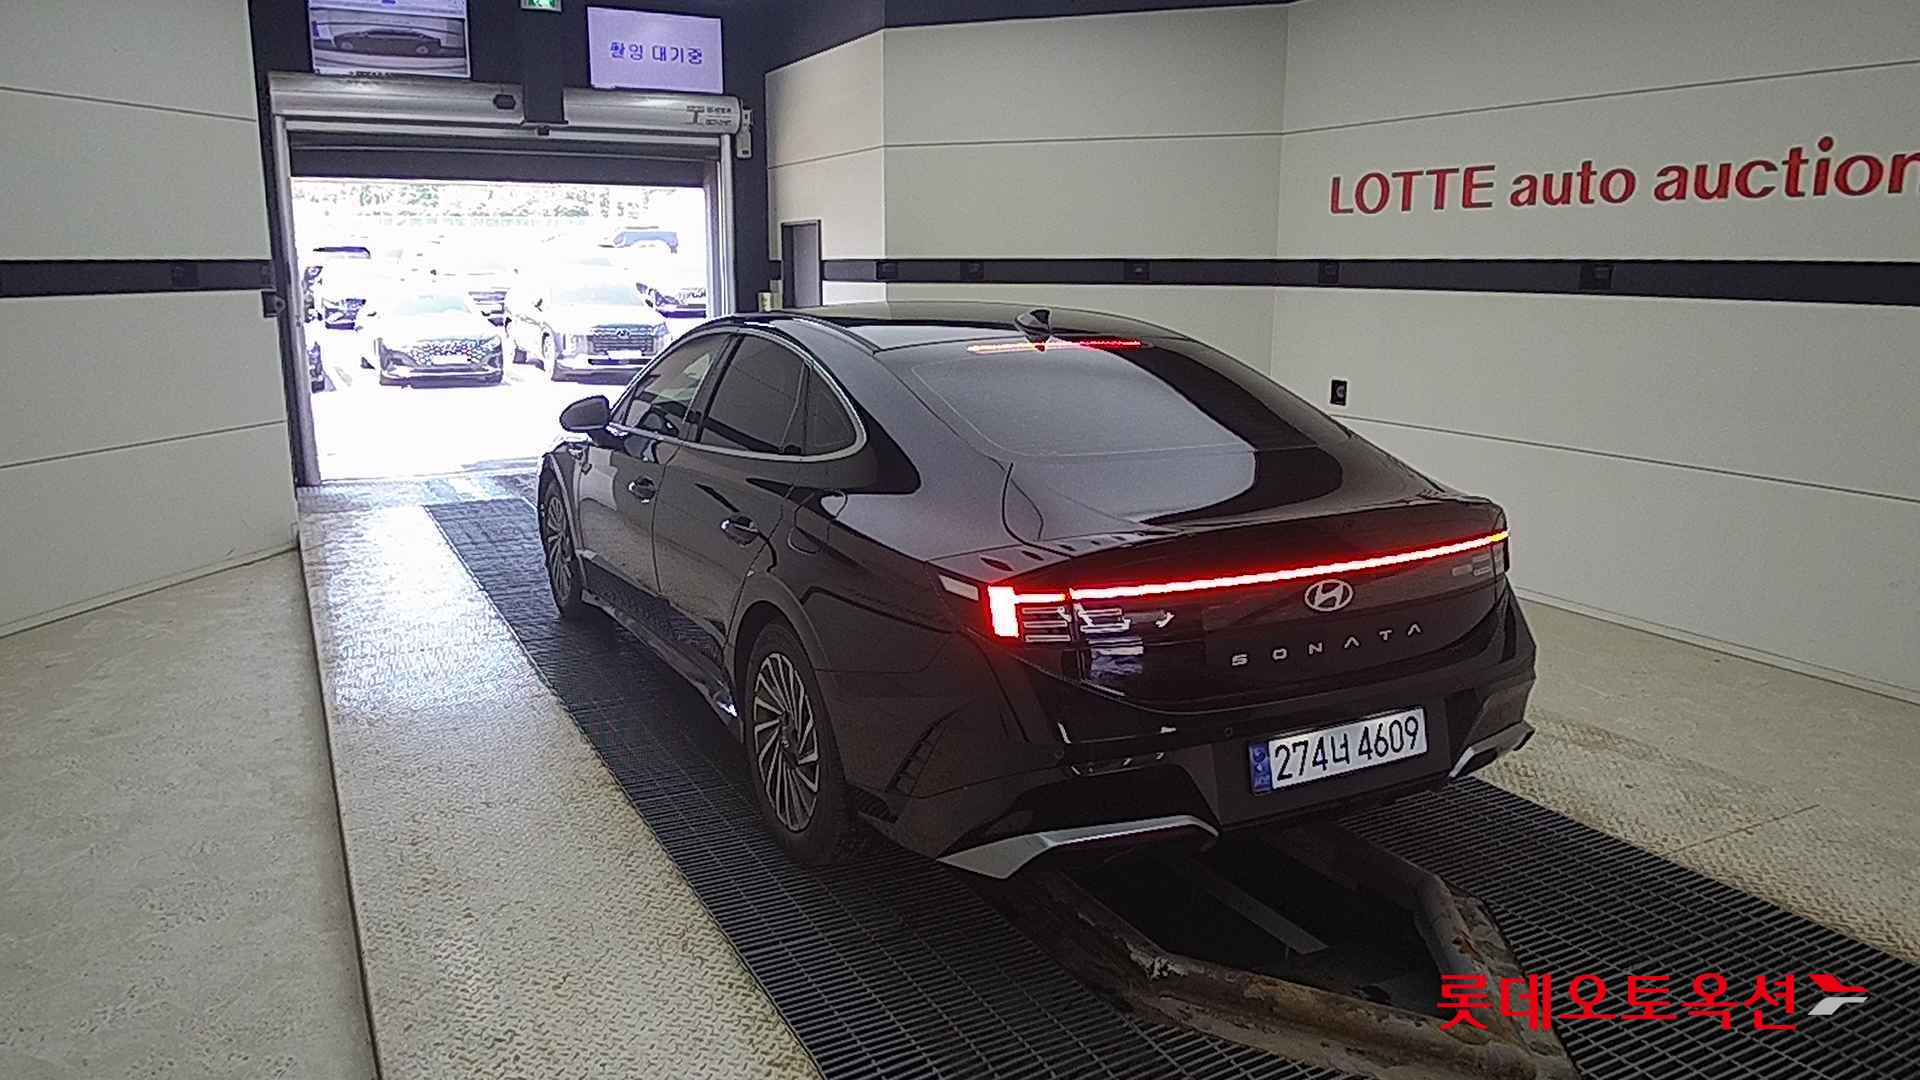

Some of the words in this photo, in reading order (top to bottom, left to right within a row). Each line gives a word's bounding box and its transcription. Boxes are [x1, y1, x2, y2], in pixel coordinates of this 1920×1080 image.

[651, 44, 703, 65] 대기중
[1330, 164, 1496, 214] LOTTE
[1510, 160, 1636, 207] auto
[1231, 623, 1422, 667] SONATA
[1274, 733, 1350, 782] 274너
[1357, 715, 1419, 761] 4609
